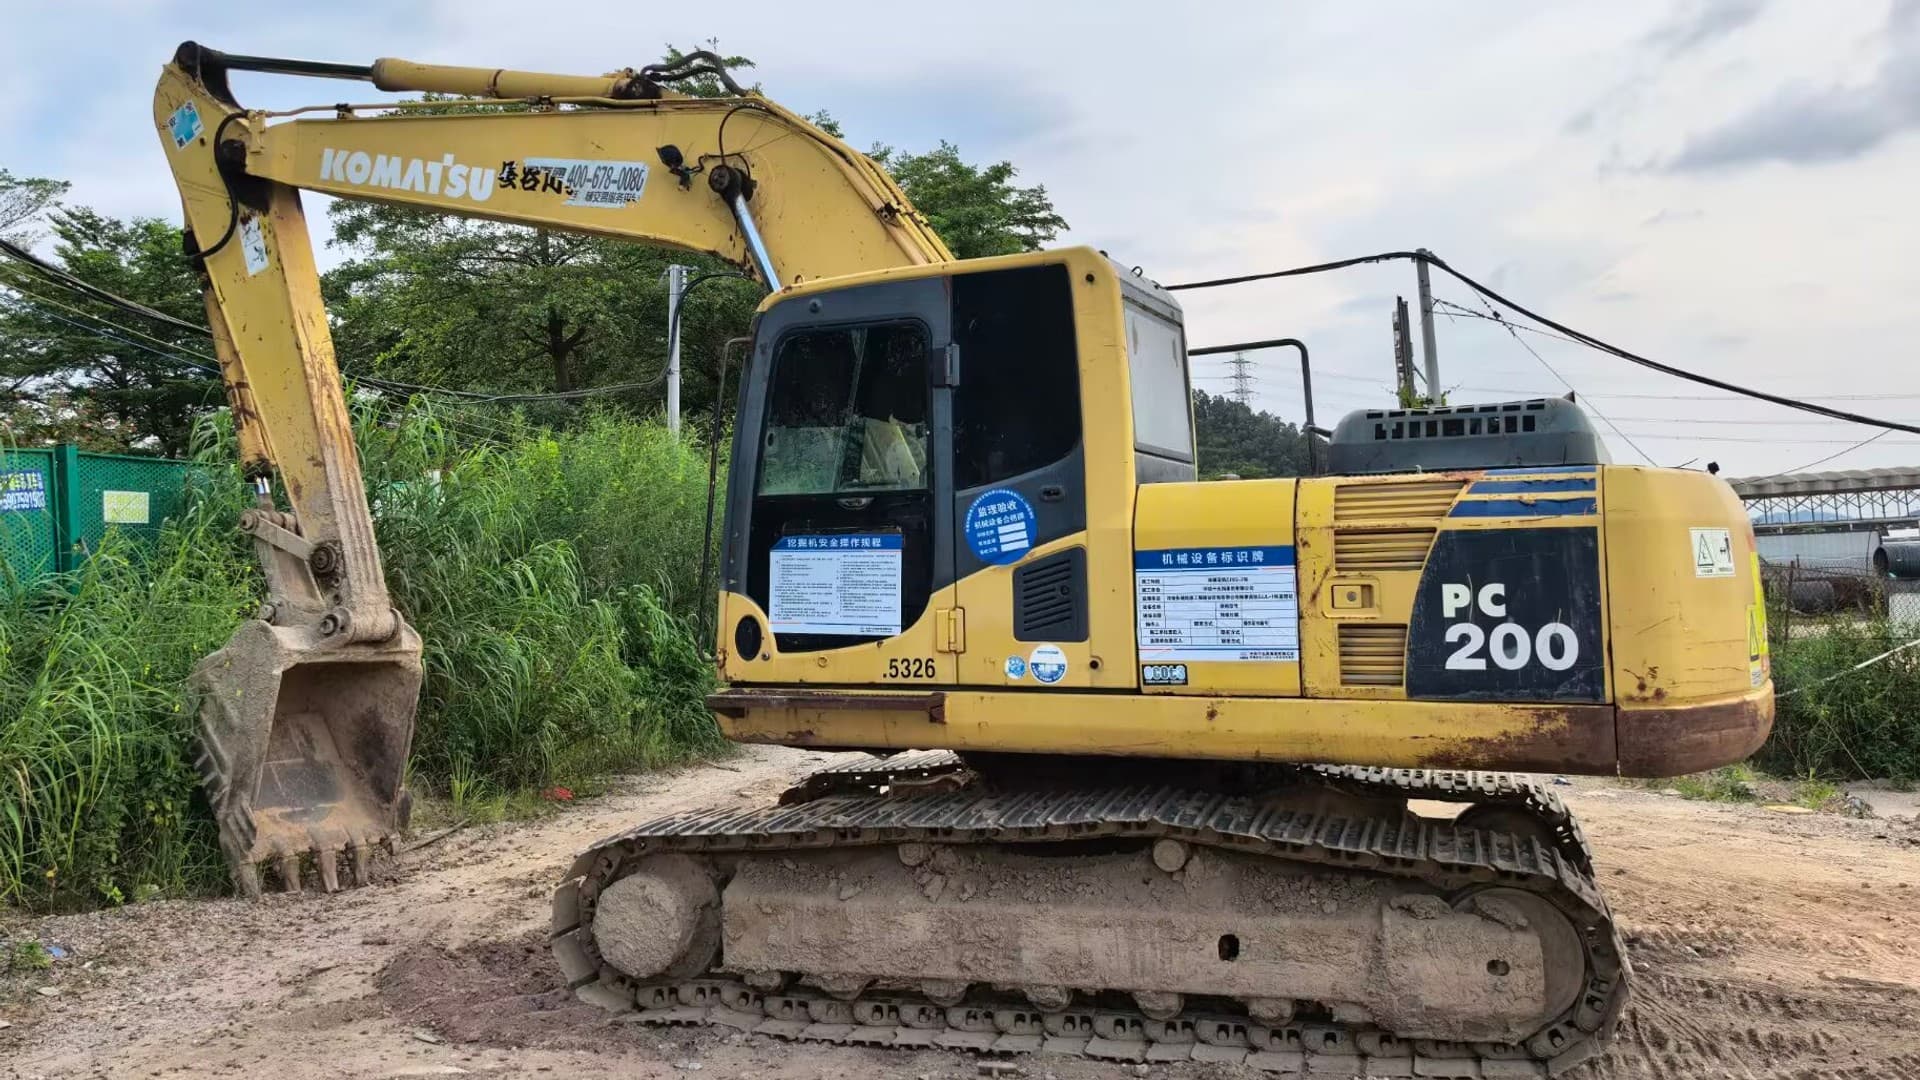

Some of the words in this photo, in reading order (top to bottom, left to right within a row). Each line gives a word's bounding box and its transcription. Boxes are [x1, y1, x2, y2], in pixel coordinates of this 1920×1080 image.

[319, 148, 496, 202] KOMATSU
[978, 500, 1018, 517] 监理验收
[787, 537, 882, 548] 挖掘机安全操作规程
[1162, 550, 1264, 566] 机械设备标识牌
[1442, 583, 1507, 618] PC
[1444, 622, 1580, 671] 200
